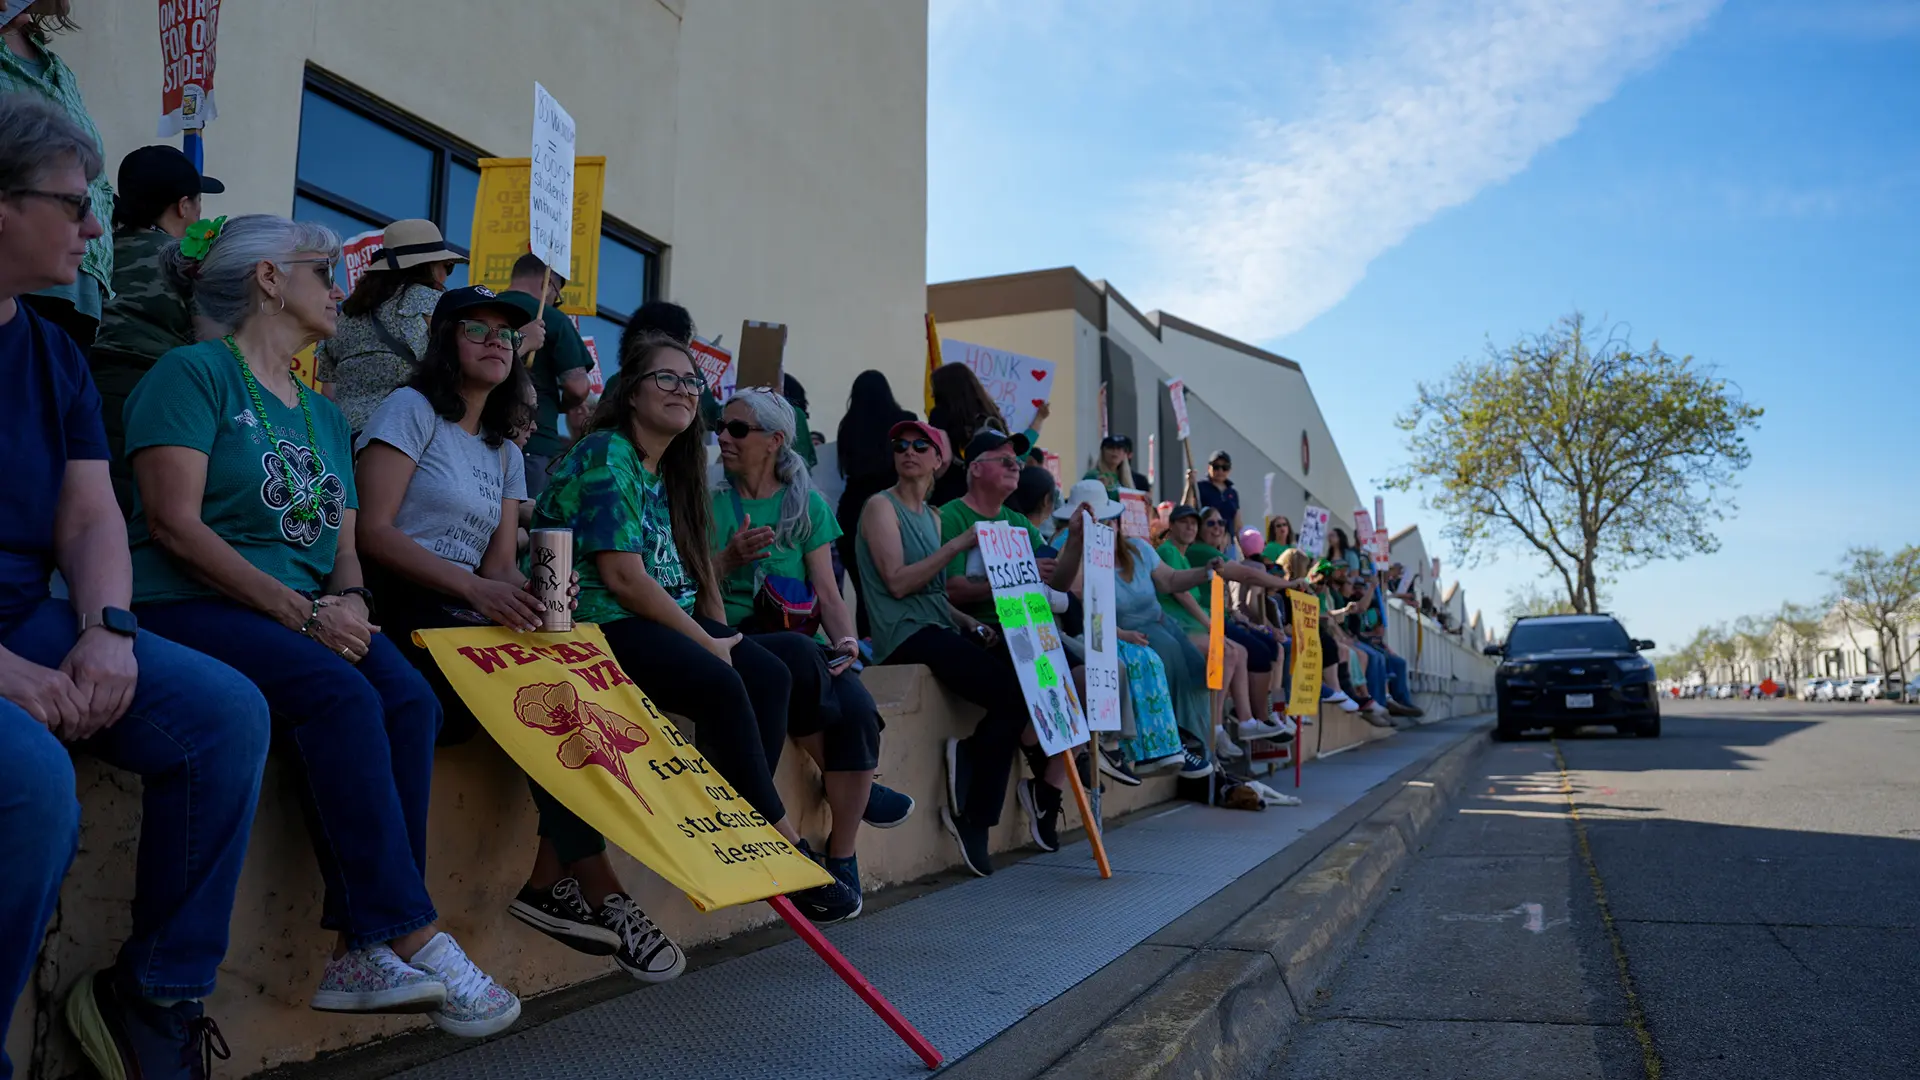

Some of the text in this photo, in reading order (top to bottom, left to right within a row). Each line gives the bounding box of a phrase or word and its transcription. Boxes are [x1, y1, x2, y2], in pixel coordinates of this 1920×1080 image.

[160, 2, 176, 31] ON
[162, 22, 187, 65] FOR
[533, 196, 562, 223] without
[346, 252, 361, 270] ON
[965, 347, 1021, 380] HONK
[979, 528, 1030, 559] TRUST
[988, 560, 1041, 588] ISSUES
[457, 643, 541, 674] WE
[1104, 670, 1118, 690] IS
[660, 725, 690, 747] th
[712, 841, 793, 865] deserve
